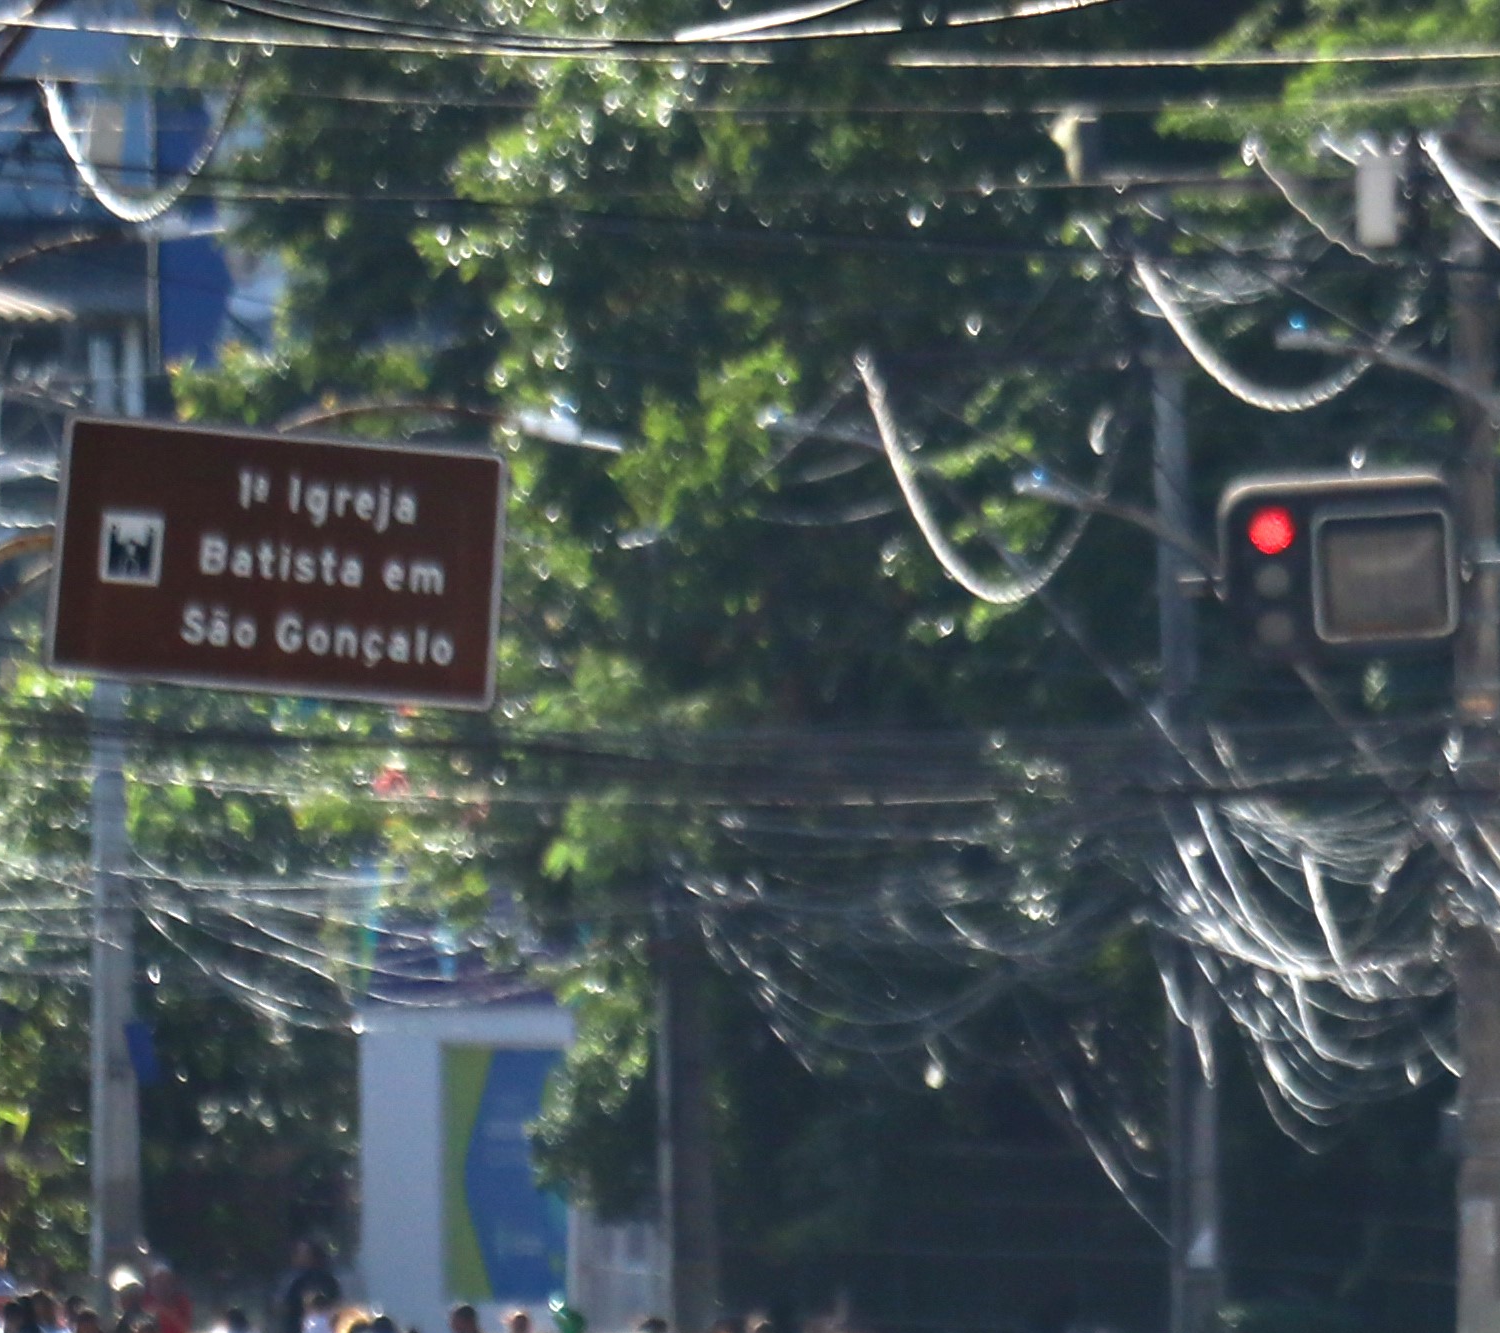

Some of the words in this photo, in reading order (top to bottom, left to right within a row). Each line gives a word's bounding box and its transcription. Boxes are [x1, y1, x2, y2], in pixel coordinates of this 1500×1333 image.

[287, 474, 416, 532] Igreja
[199, 536, 363, 588] Batista
[382, 560, 444, 595] em
[181, 604, 258, 648] São
[275, 612, 455, 667] Gonçalo
